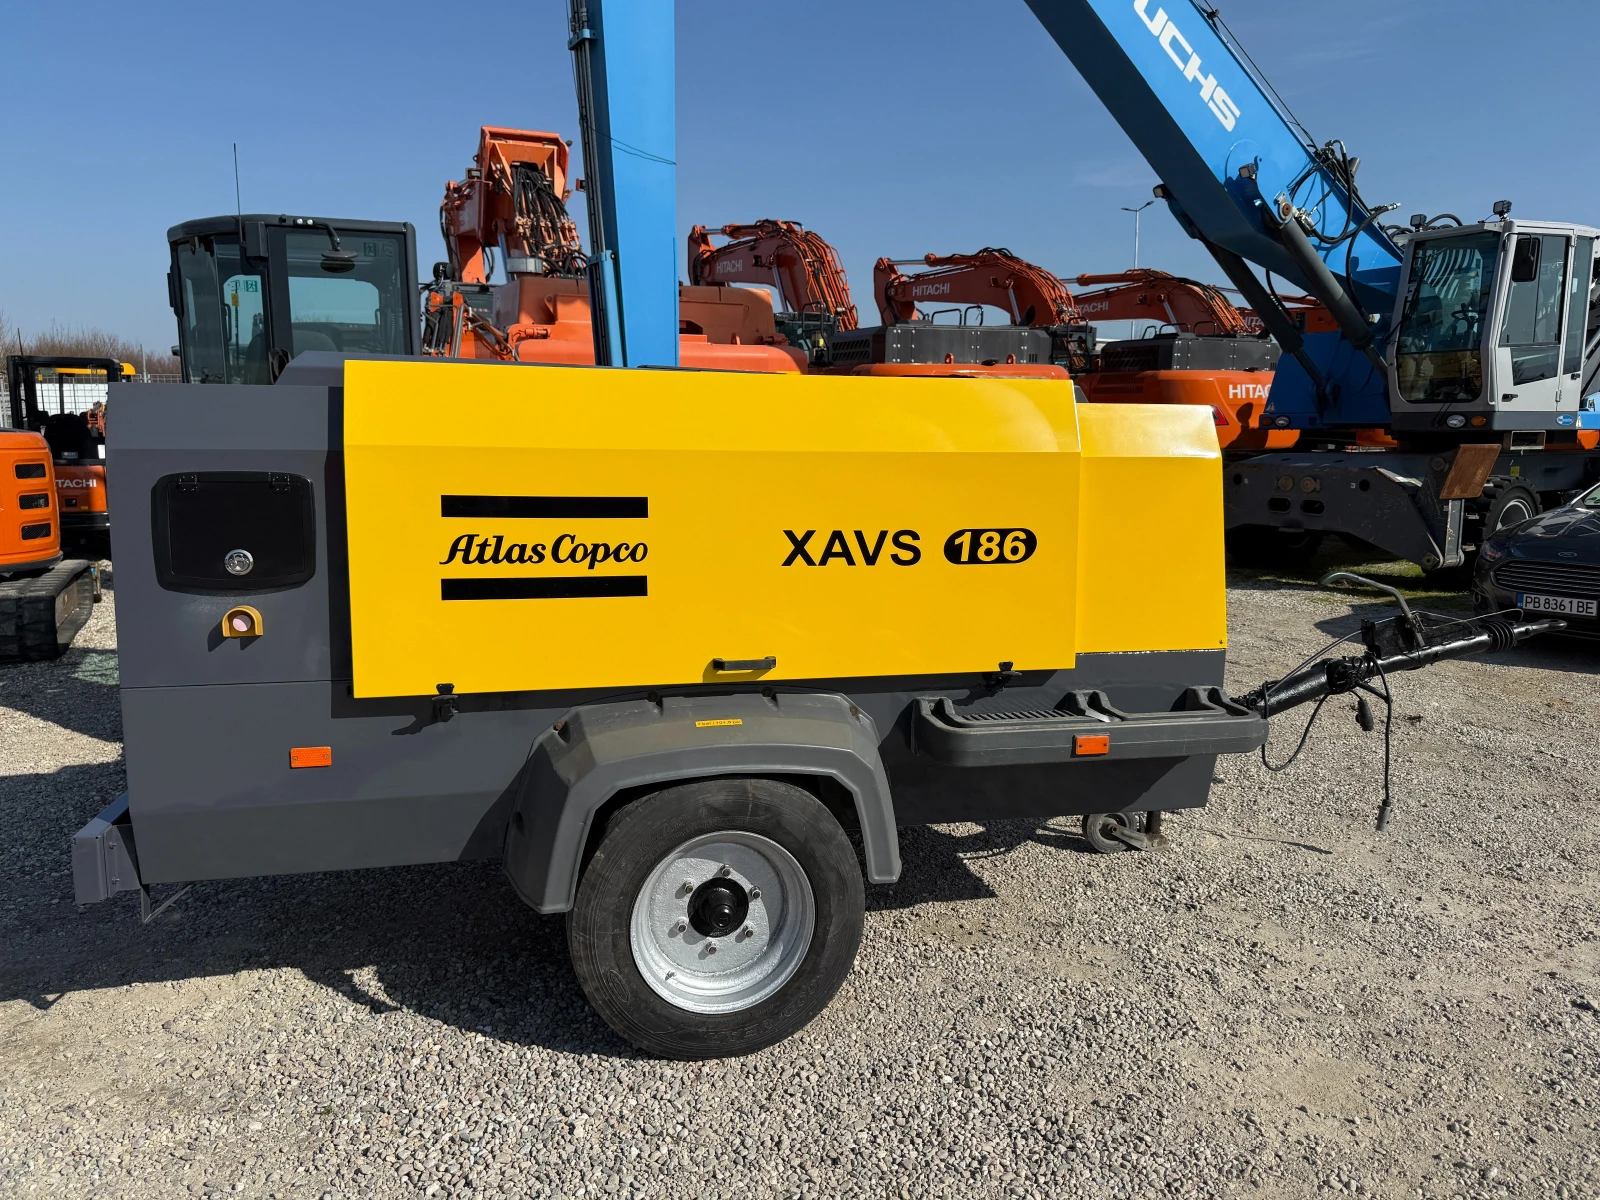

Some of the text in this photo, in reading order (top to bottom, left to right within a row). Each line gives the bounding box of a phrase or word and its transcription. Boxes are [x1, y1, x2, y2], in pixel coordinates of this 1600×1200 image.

[1133, 0, 1241, 132] UCHS
[716, 259, 743, 274] HITACHI
[912, 282, 950, 297] HITACHI
[55, 478, 97, 488] TACHI
[439, 533, 648, 570] Atlas Copco
[781, 529, 1027, 567] XAVS 186
[1524, 595, 1594, 615] PB 8361 BE
